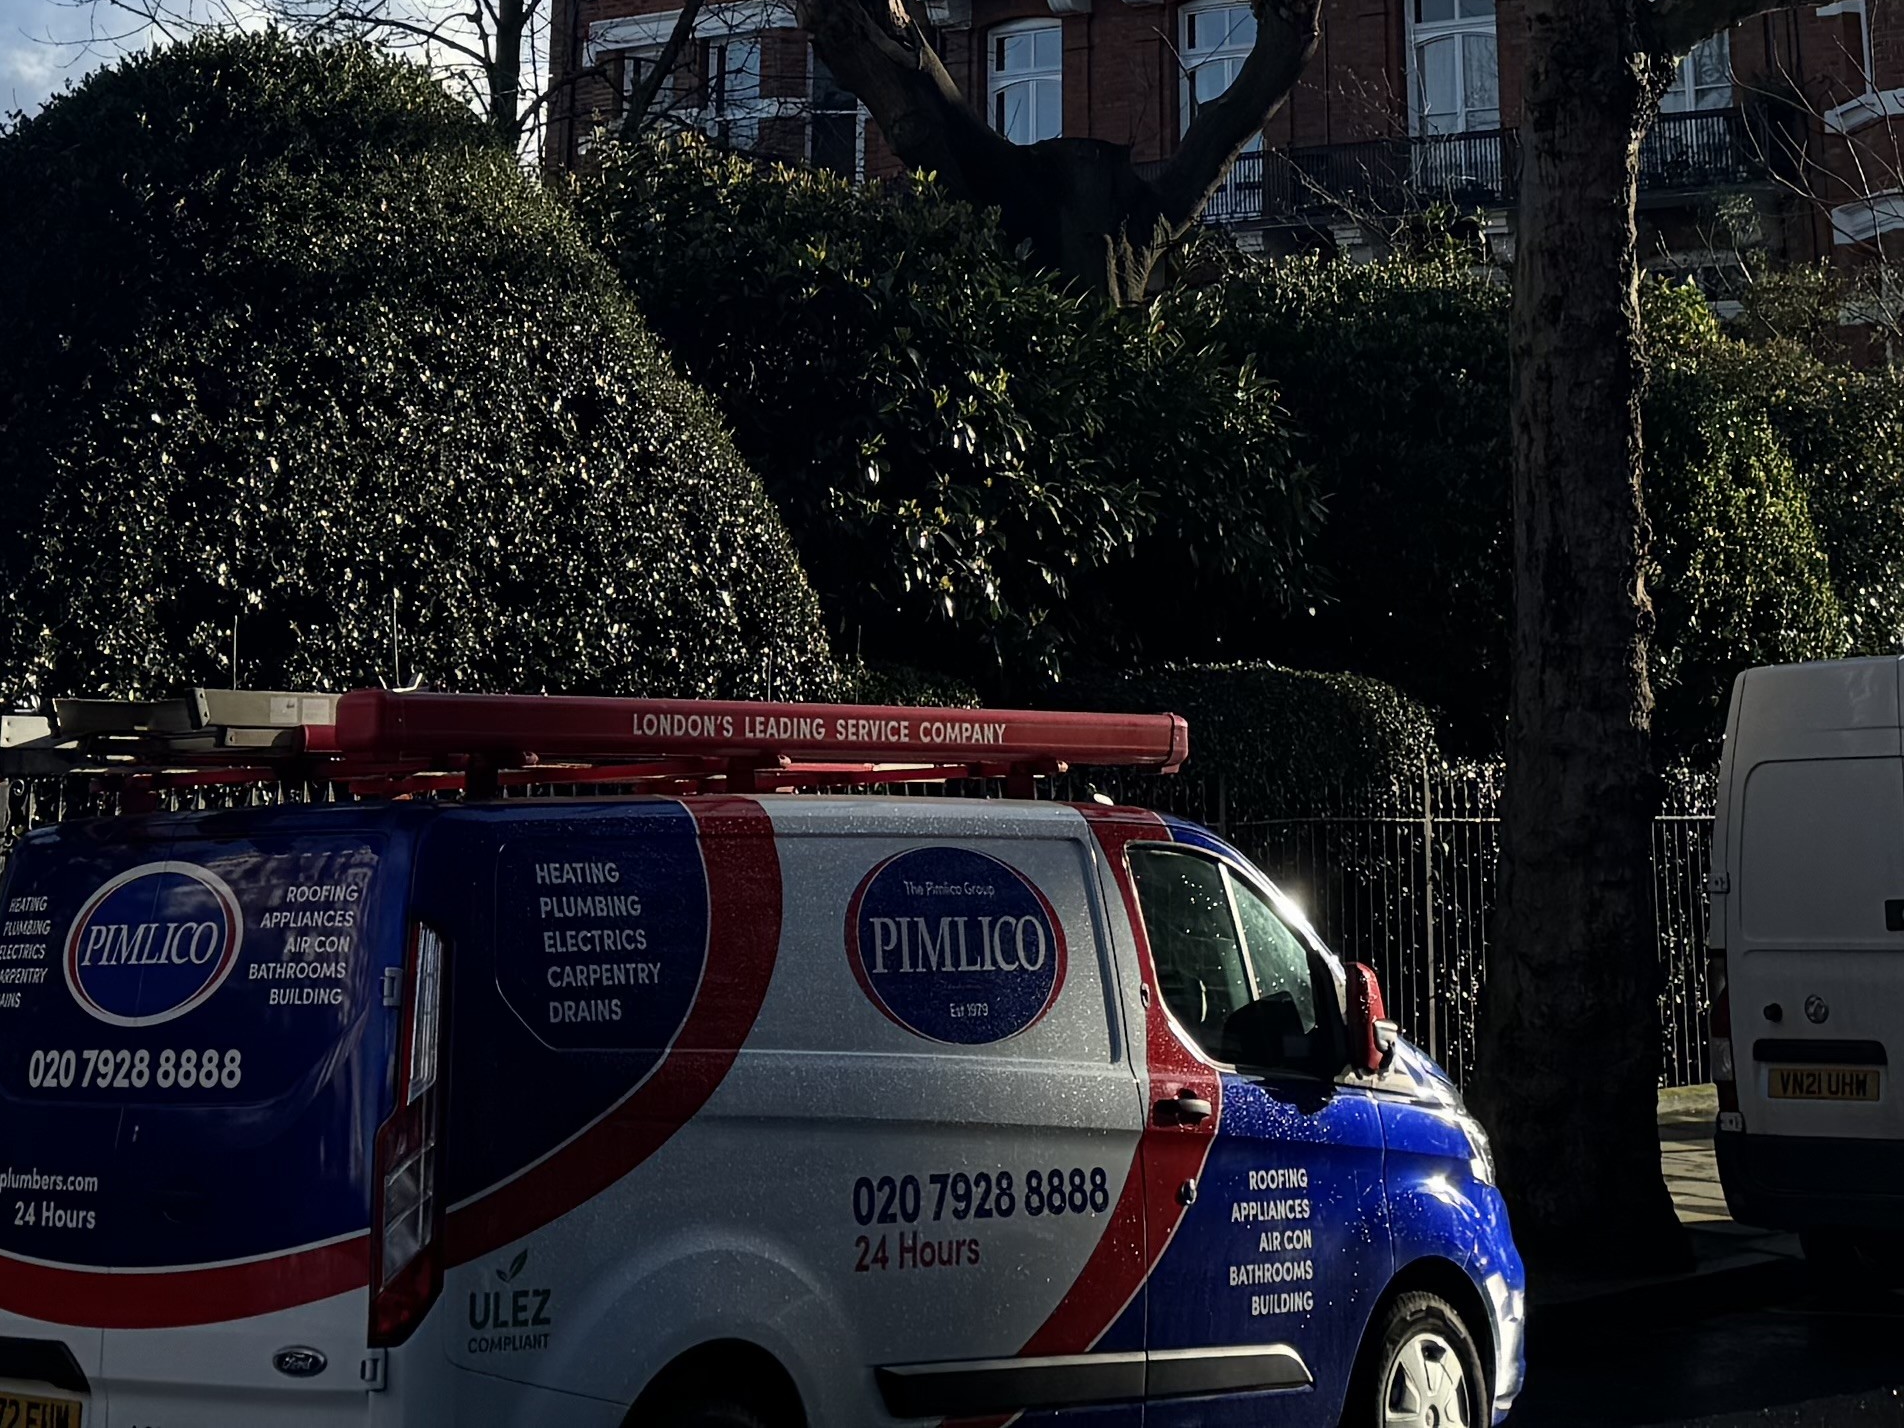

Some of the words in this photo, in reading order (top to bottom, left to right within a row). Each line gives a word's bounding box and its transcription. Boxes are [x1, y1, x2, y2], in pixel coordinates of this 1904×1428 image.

[633, 713, 734, 738] LONDON'S
[744, 716, 826, 740] LEADING
[836, 719, 910, 743] SERVICE
[919, 721, 1006, 744] COMPANY
[535, 862, 620, 885] HEATING
[287, 885, 358, 902] ROOFING
[903, 881, 923, 896] The
[964, 882, 995, 897] Group
[9, 896, 47, 913] HEATING
[539, 895, 641, 918] PLUMBING
[3, 920, 50, 936] PLUMBING
[261, 911, 354, 928] APPLIANCES
[81, 922, 218, 966] PIMLICO
[284, 937, 310, 953] AIR
[314, 936, 349, 953] CON
[543, 929, 647, 953] ELECTRICS
[869, 915, 1046, 974] PIMLICO
[248, 962, 346, 979] BATHROOMS
[547, 962, 661, 987] CARPENTRY
[269, 988, 342, 1005] BUILDING
[549, 999, 622, 1023] DRAINS
[950, 1003, 964, 1017] Est
[966, 1003, 989, 1016] 1979
[29, 1049, 76, 1088] 020
[81, 1049, 150, 1087] 7928
[157, 1049, 242, 1088] 8888
[1780, 1071, 1822, 1095] VN21
[1827, 1073, 1868, 1097] UHW
[1249, 1168, 1308, 1190] ROOFING
[853, 1174, 921, 1226] 020
[929, 1170, 1016, 1221] 7928
[1024, 1167, 1109, 1216] 8888
[14, 1201, 35, 1226] 24
[41, 1201, 96, 1229] Hours
[1231, 1199, 1310, 1222] APPLIANCES
[855, 1234, 889, 1272] 24
[899, 1231, 980, 1269] Hours
[1259, 1232, 1280, 1252] AIR
[1284, 1229, 1312, 1250] CON
[1230, 1260, 1313, 1286] BATHROOMS
[469, 1289, 551, 1330] ULEZ
[1252, 1291, 1313, 1316] BUILDING
[468, 1333, 550, 1354] COMPLIANT
